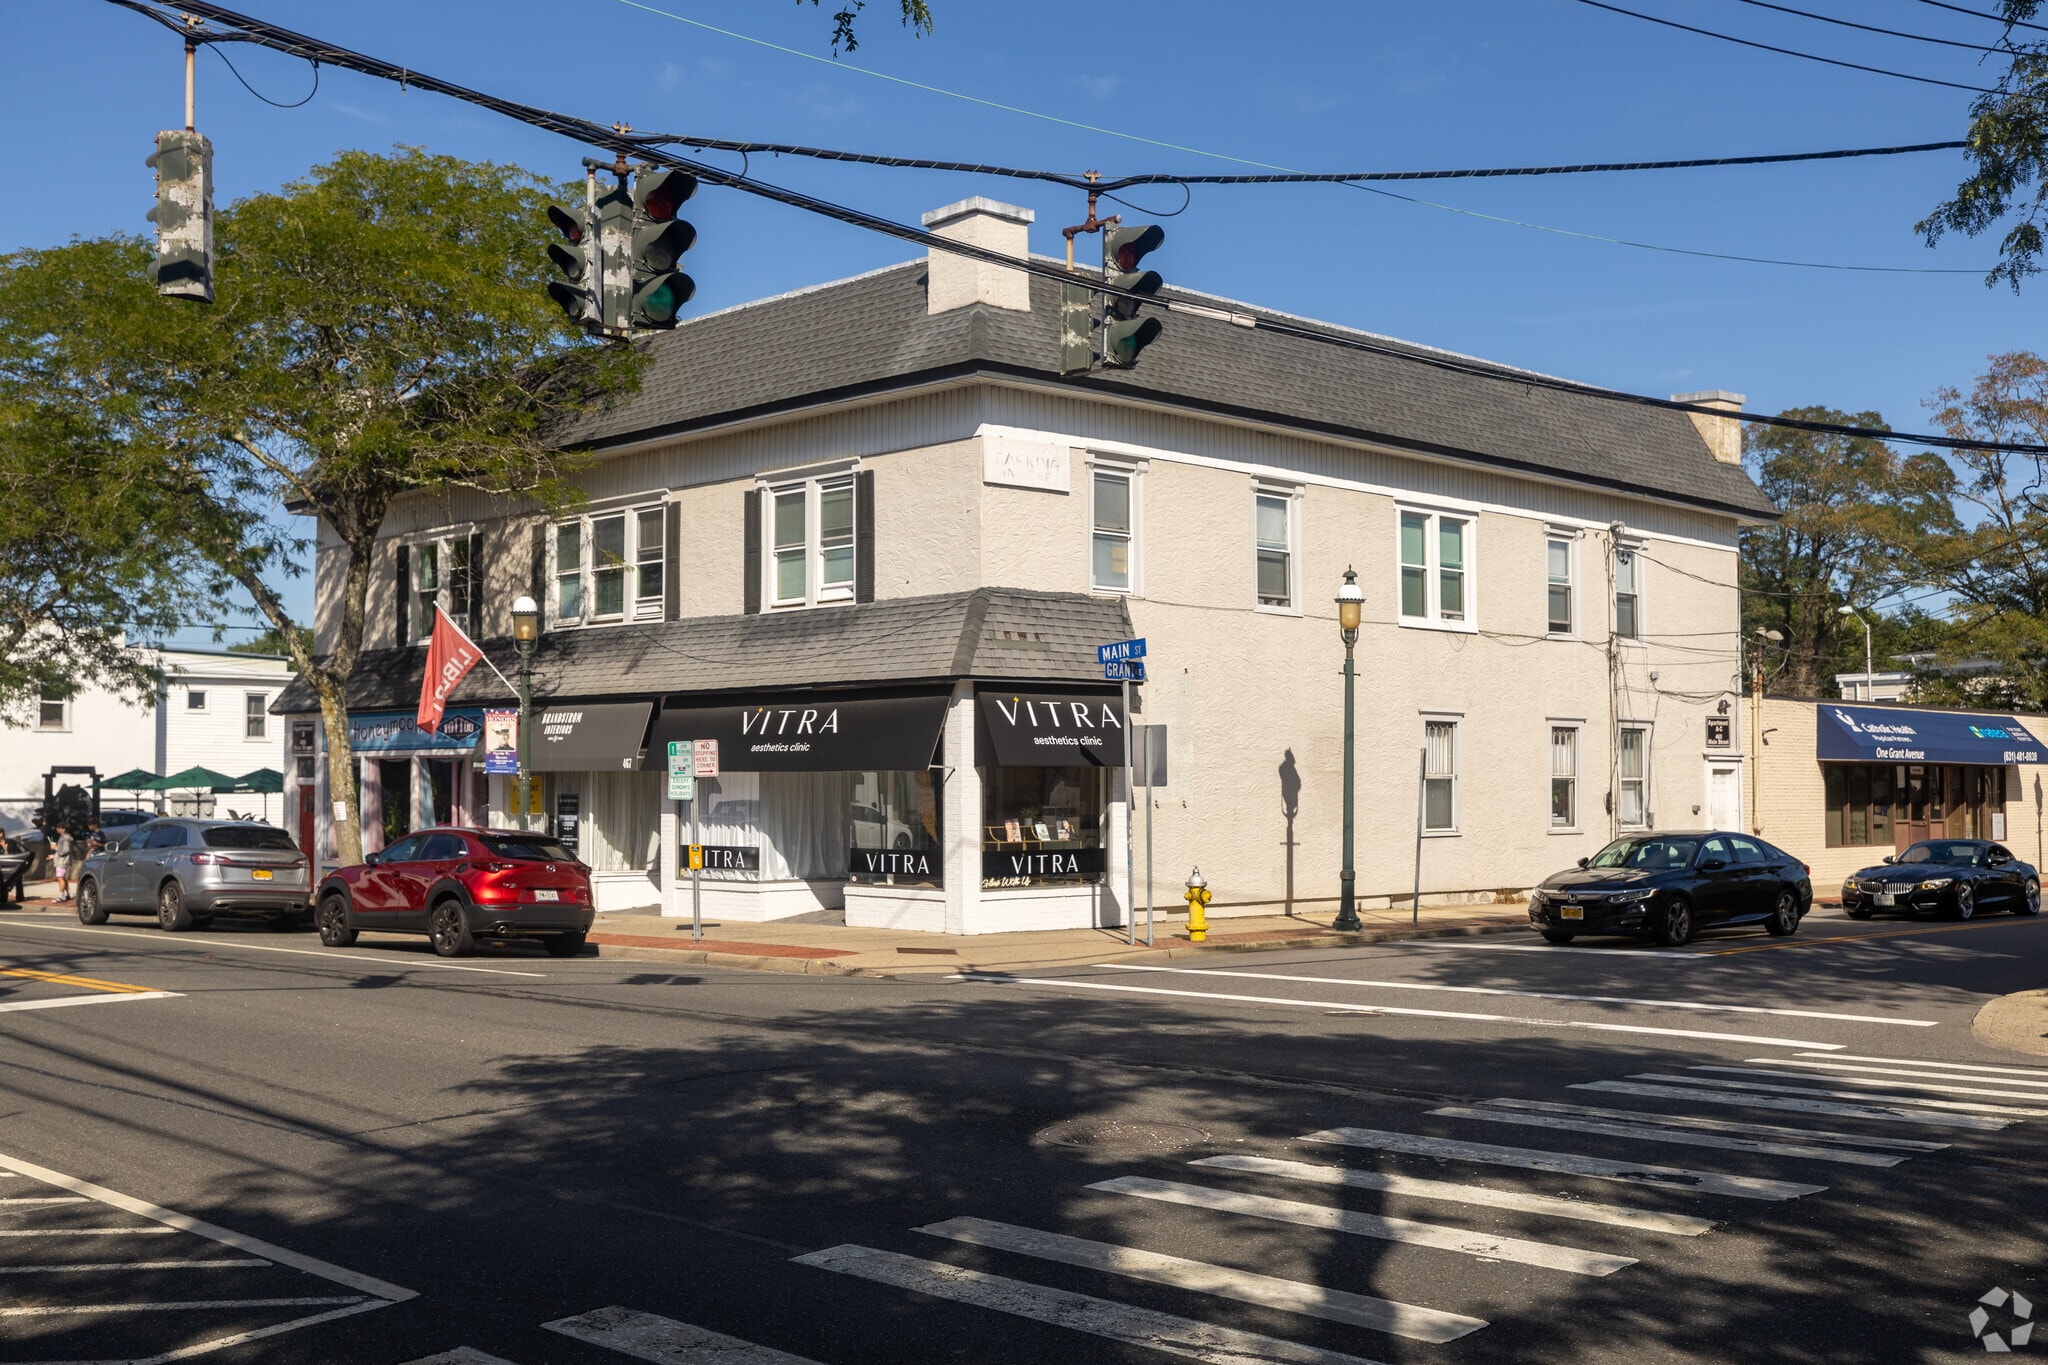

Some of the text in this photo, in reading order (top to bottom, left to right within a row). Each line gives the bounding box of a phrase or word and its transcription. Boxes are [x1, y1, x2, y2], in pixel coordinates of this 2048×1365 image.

[1102, 643, 1141, 661] MAIN ST
[541, 712, 583, 724] BRANDSTROM
[996, 697, 1122, 728] VITRA
[743, 706, 838, 735] VITRA
[544, 724, 573, 735] INTERIORS
[751, 742, 811, 752] aesthetics clinic
[1034, 735, 1103, 746] aesthetics clinic
[1876, 747, 1925, 760] One Grant Avenue
[622, 758, 632, 769] 467
[704, 849, 745, 868] ITRA
[866, 852, 930, 874] VITRA
[1011, 853, 1079, 874] VITRA
